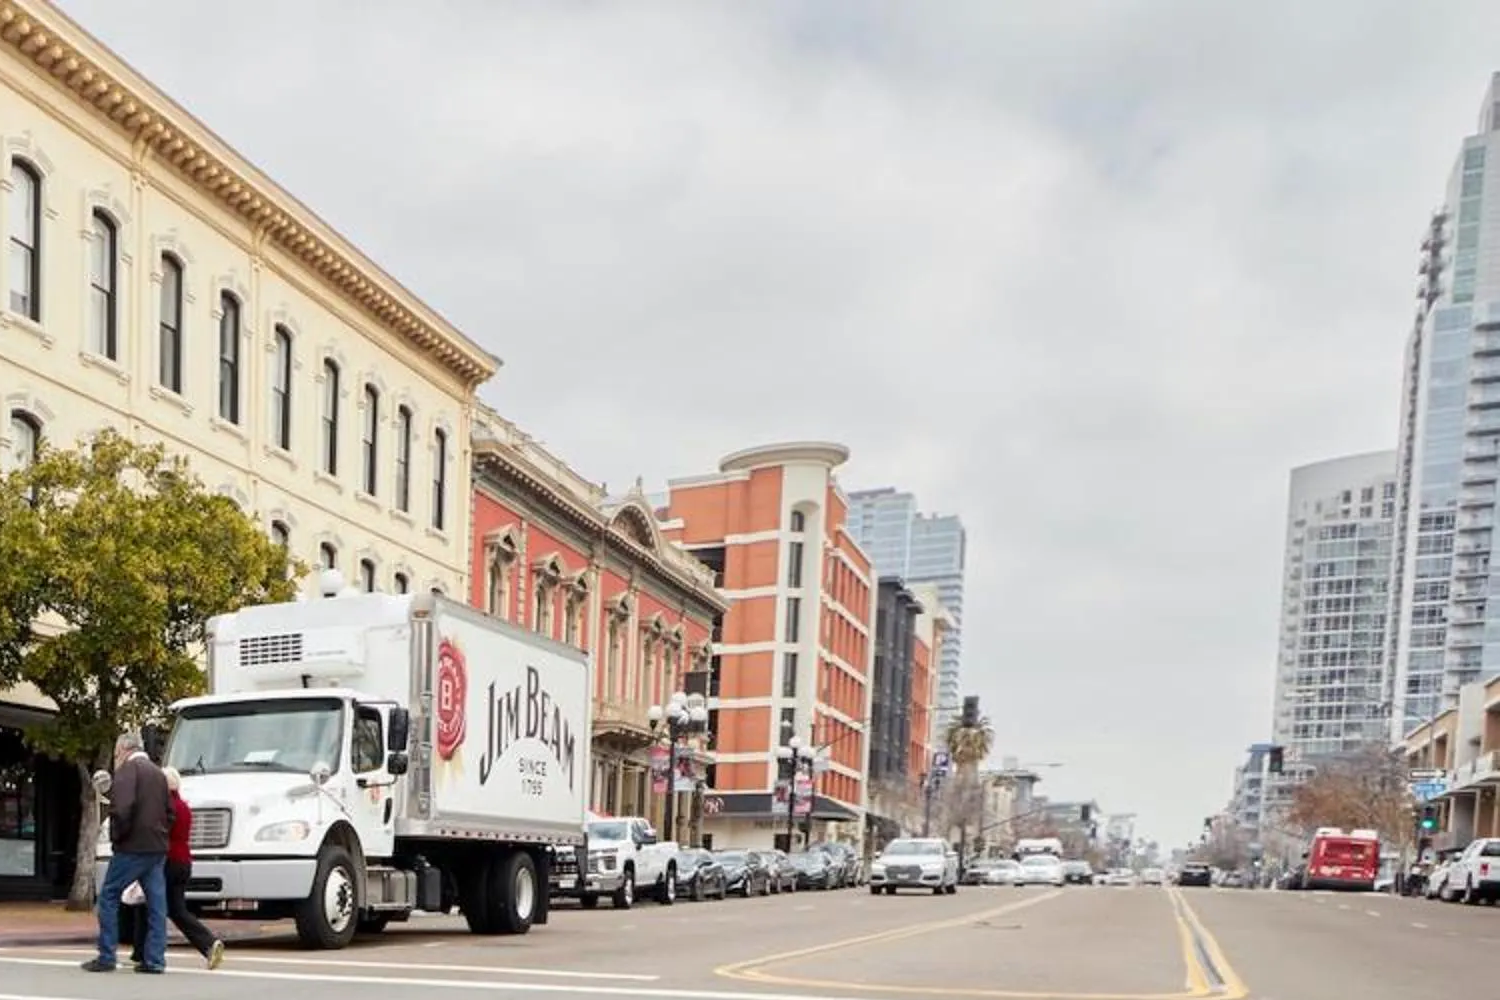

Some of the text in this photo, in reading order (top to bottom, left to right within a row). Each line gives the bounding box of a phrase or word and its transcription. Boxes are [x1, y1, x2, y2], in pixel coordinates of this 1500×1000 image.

[479, 665, 575, 793] JIM BEAM
[519, 757, 547, 777] SINCE
